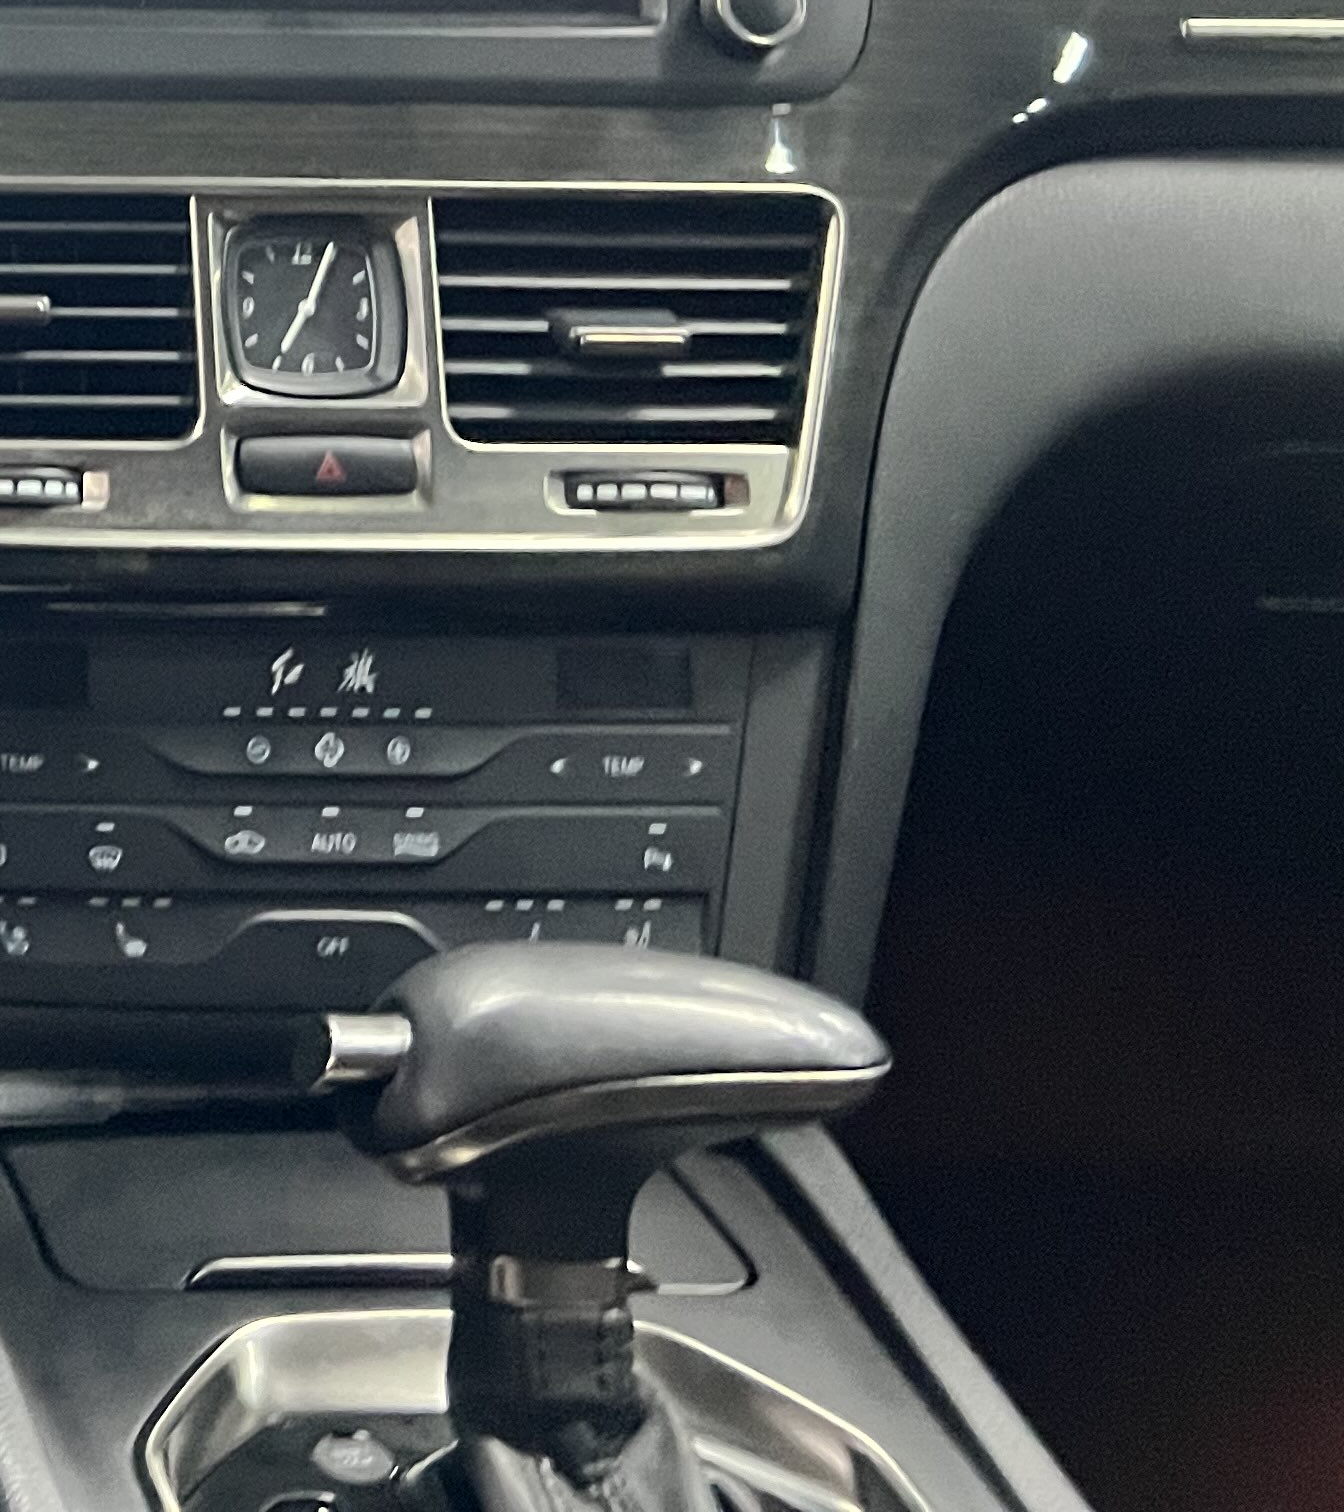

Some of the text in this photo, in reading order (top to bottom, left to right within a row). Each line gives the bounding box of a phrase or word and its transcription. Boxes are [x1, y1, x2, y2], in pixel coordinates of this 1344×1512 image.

[0, 752, 44, 772] TEMP
[603, 755, 645, 776] TEMP
[311, 832, 357, 855] AUTO
